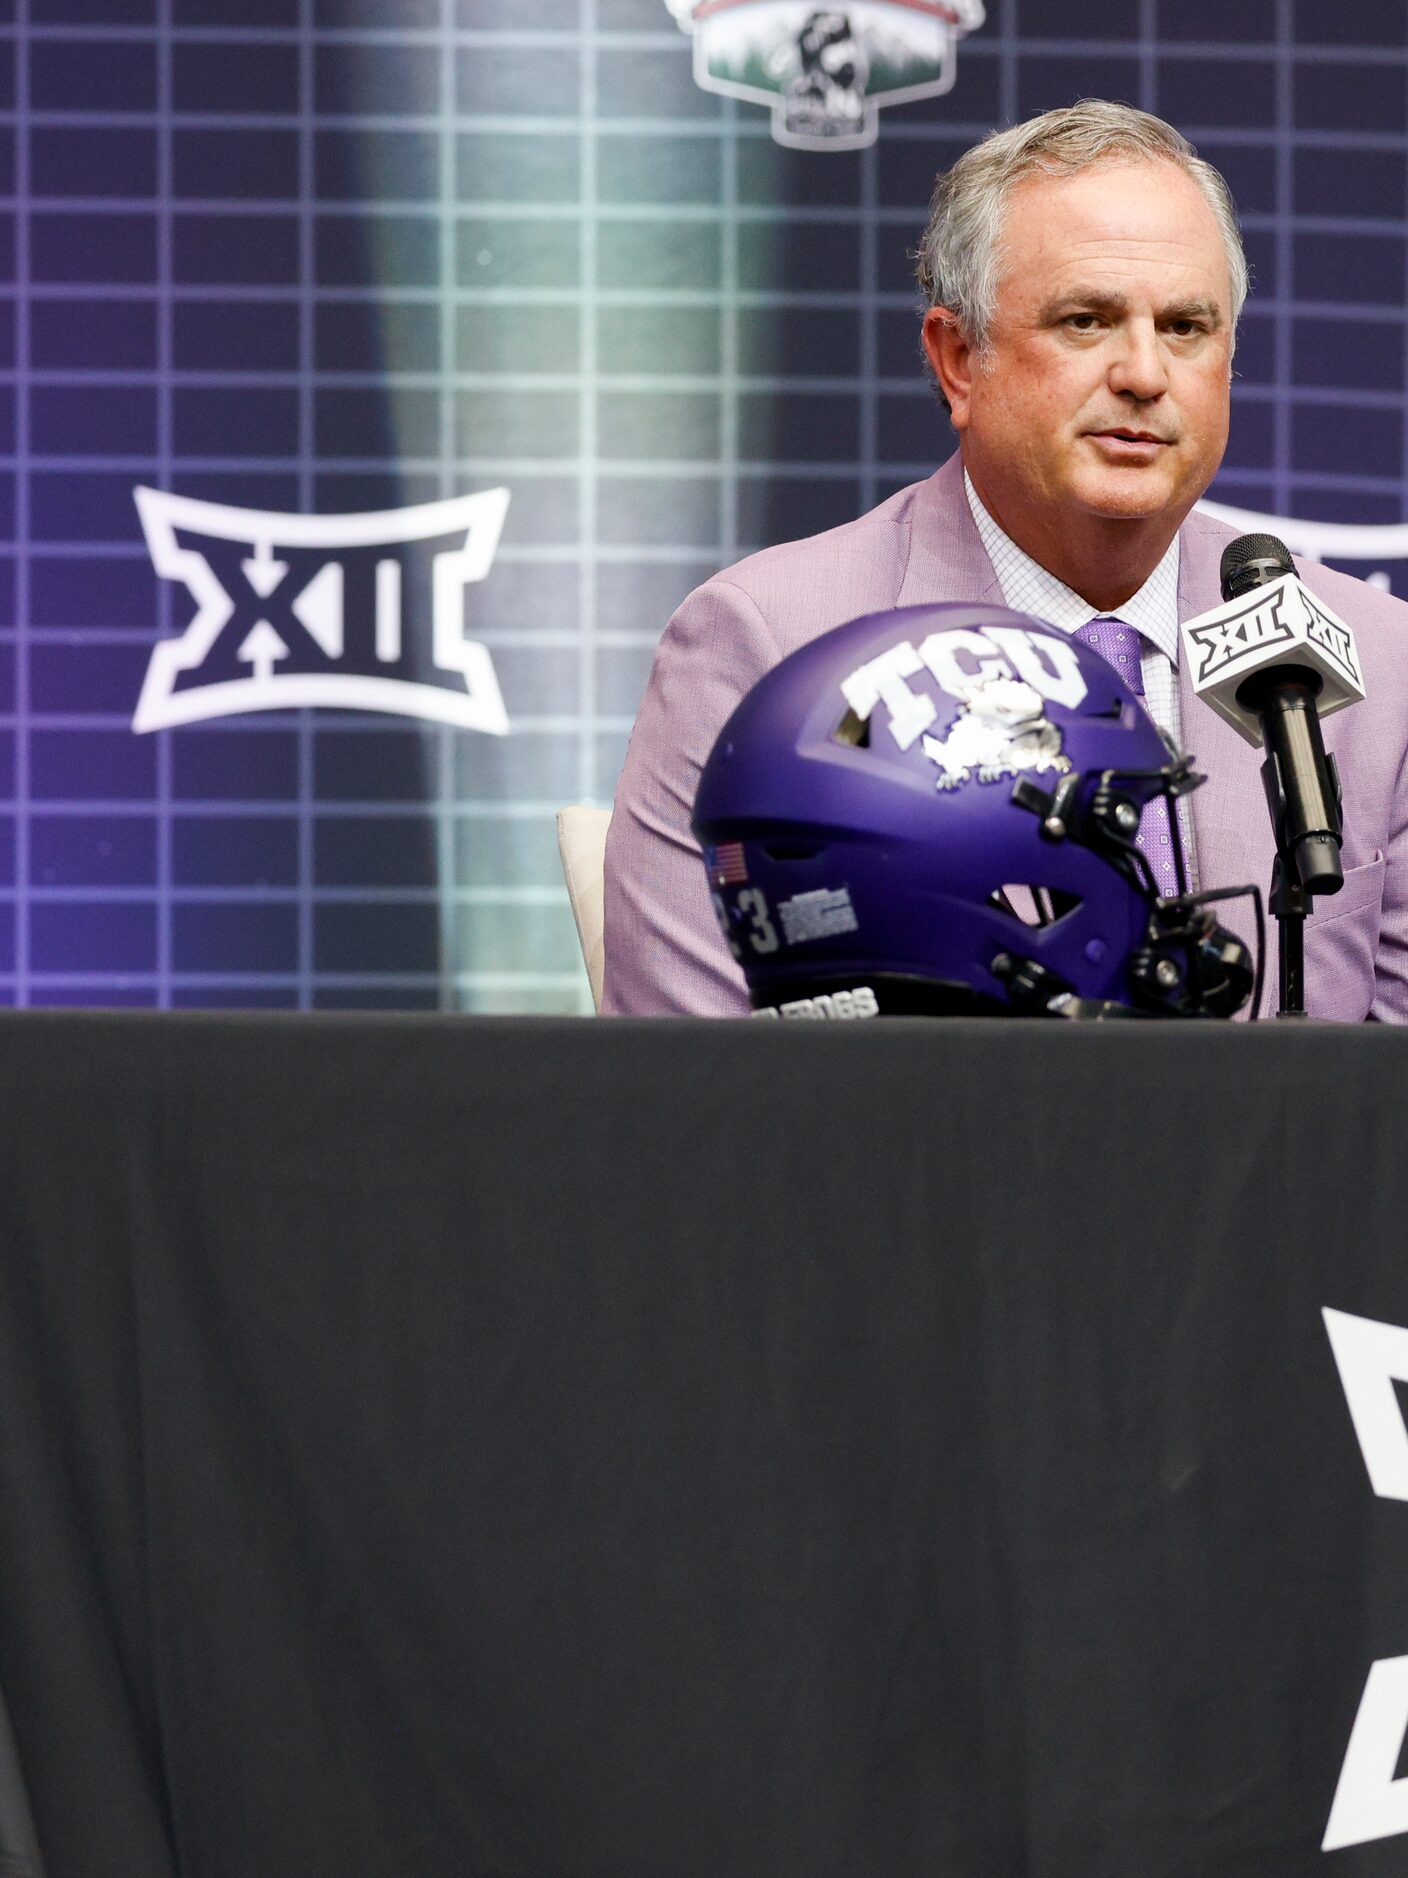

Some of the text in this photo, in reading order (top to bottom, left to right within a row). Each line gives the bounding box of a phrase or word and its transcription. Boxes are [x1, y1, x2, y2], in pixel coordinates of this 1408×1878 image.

[155, 510, 490, 712] XII
[1192, 590, 1291, 680] XII
[840, 626, 1088, 750] TCU
